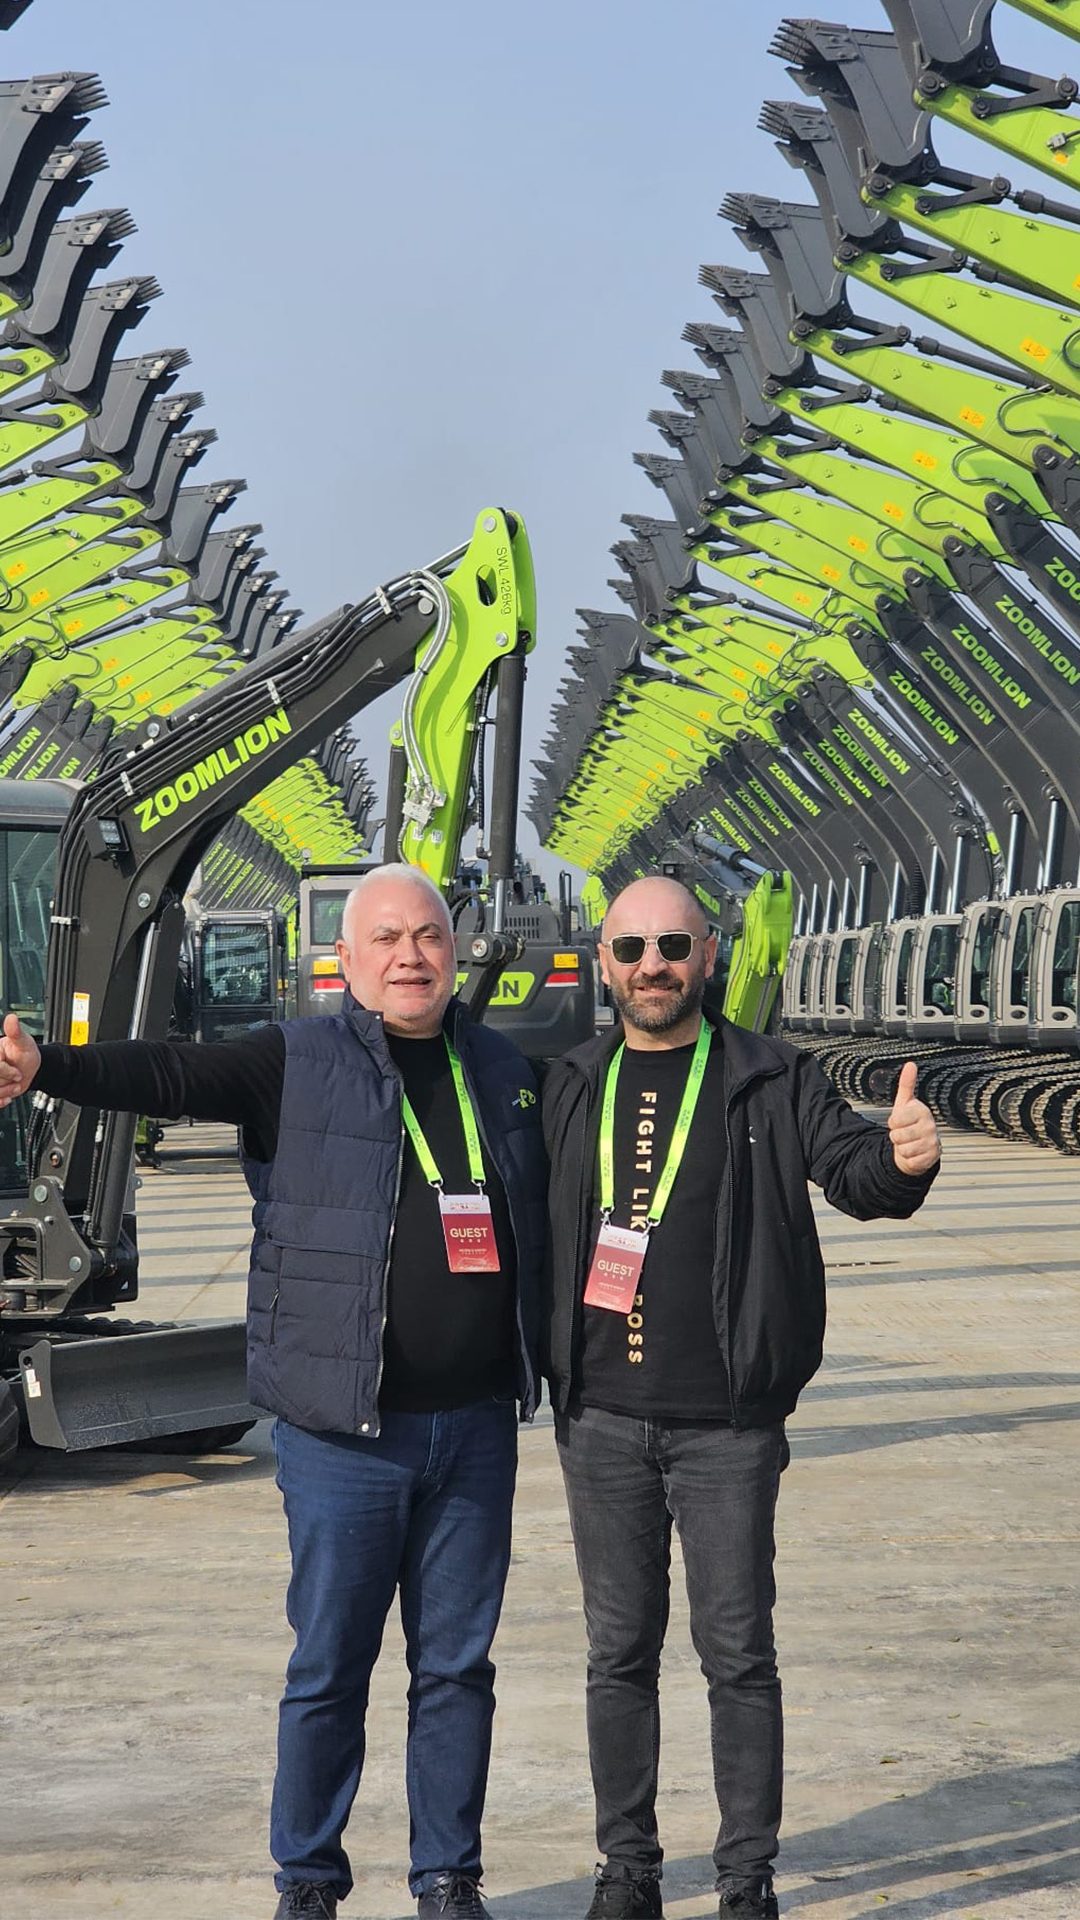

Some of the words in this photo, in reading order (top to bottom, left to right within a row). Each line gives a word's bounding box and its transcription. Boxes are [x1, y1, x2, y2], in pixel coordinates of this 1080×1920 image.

[496, 547, 509, 576] SWL
[951, 623, 1031, 709] ZOOMLION
[994, 594, 1080, 685] ZOOMLION
[889, 671, 960, 745] ZOOMLION
[920, 646, 995, 725] ZOOMLION
[133, 708, 292, 833] ZOOMLION
[832, 724, 889, 788] ZOOMLION
[848, 708, 910, 775] ZOOMLION
[768, 762, 821, 817] ZOOMLION
[709, 807, 752, 853] ZOOMLION
[635, 1091, 657, 1173] FIGHT
[449, 1227, 488, 1238] GUEST
[630, 1188, 650, 1230] LIK
[597, 1259, 635, 1277] GUEST
